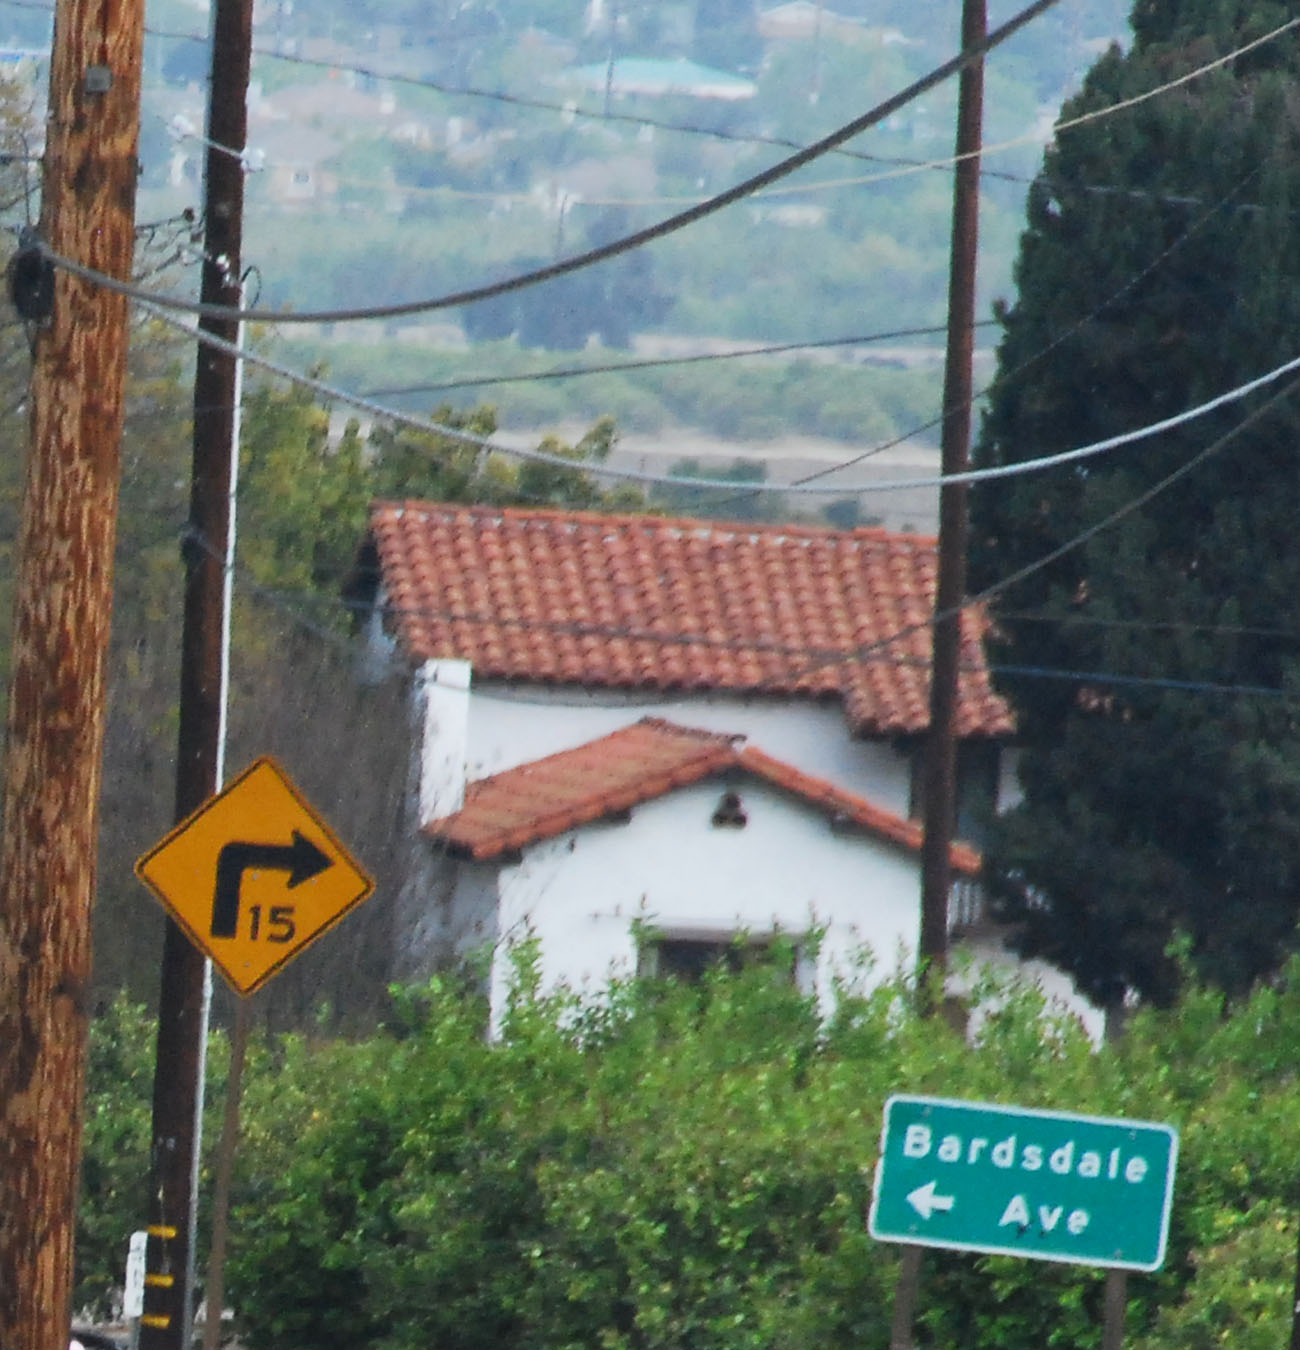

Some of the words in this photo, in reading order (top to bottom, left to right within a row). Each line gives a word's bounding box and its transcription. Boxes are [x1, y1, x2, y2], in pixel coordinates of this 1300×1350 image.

[248, 904, 296, 943] 15
[903, 1124, 1148, 1184] Bardsdale
[998, 1195, 1090, 1235] Ave
